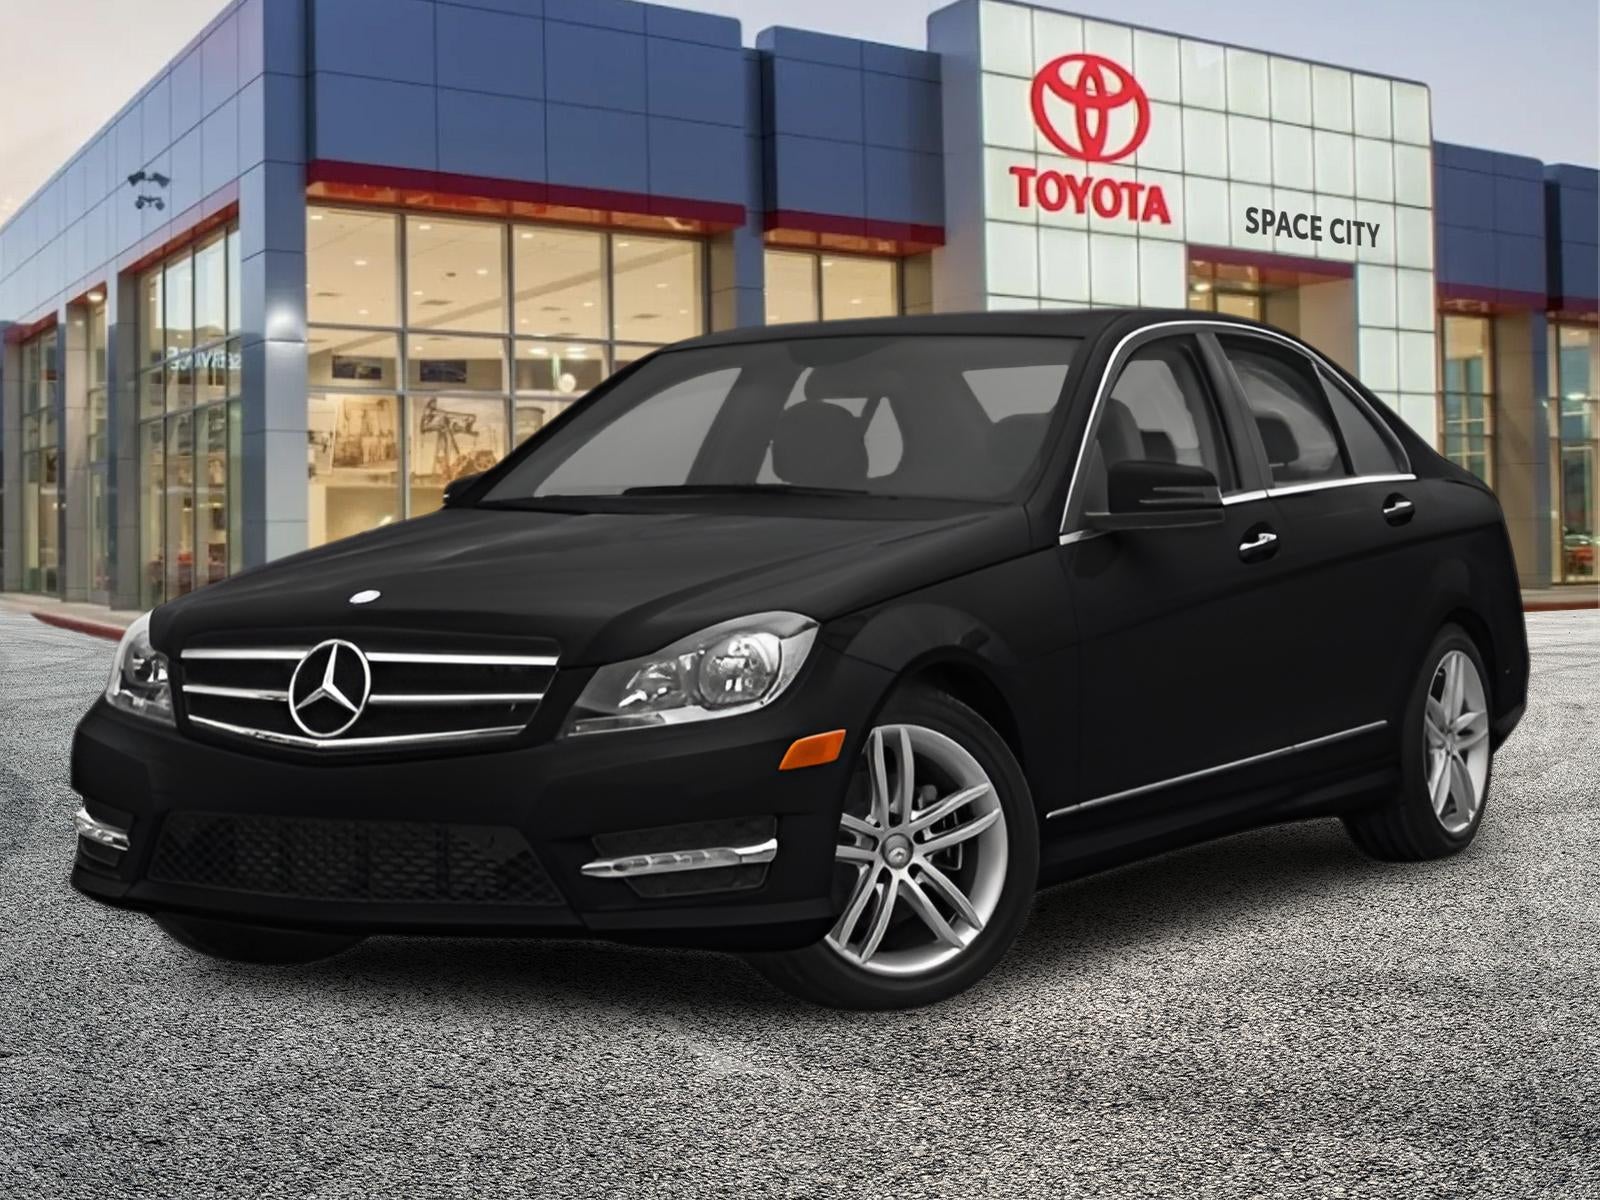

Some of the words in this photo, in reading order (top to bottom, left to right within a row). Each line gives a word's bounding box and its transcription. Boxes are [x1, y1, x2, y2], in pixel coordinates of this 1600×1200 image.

[1009, 166, 1171, 224] TOYOTA
[1245, 207, 1322, 241] SPACE
[1329, 218, 1380, 248] CITY
